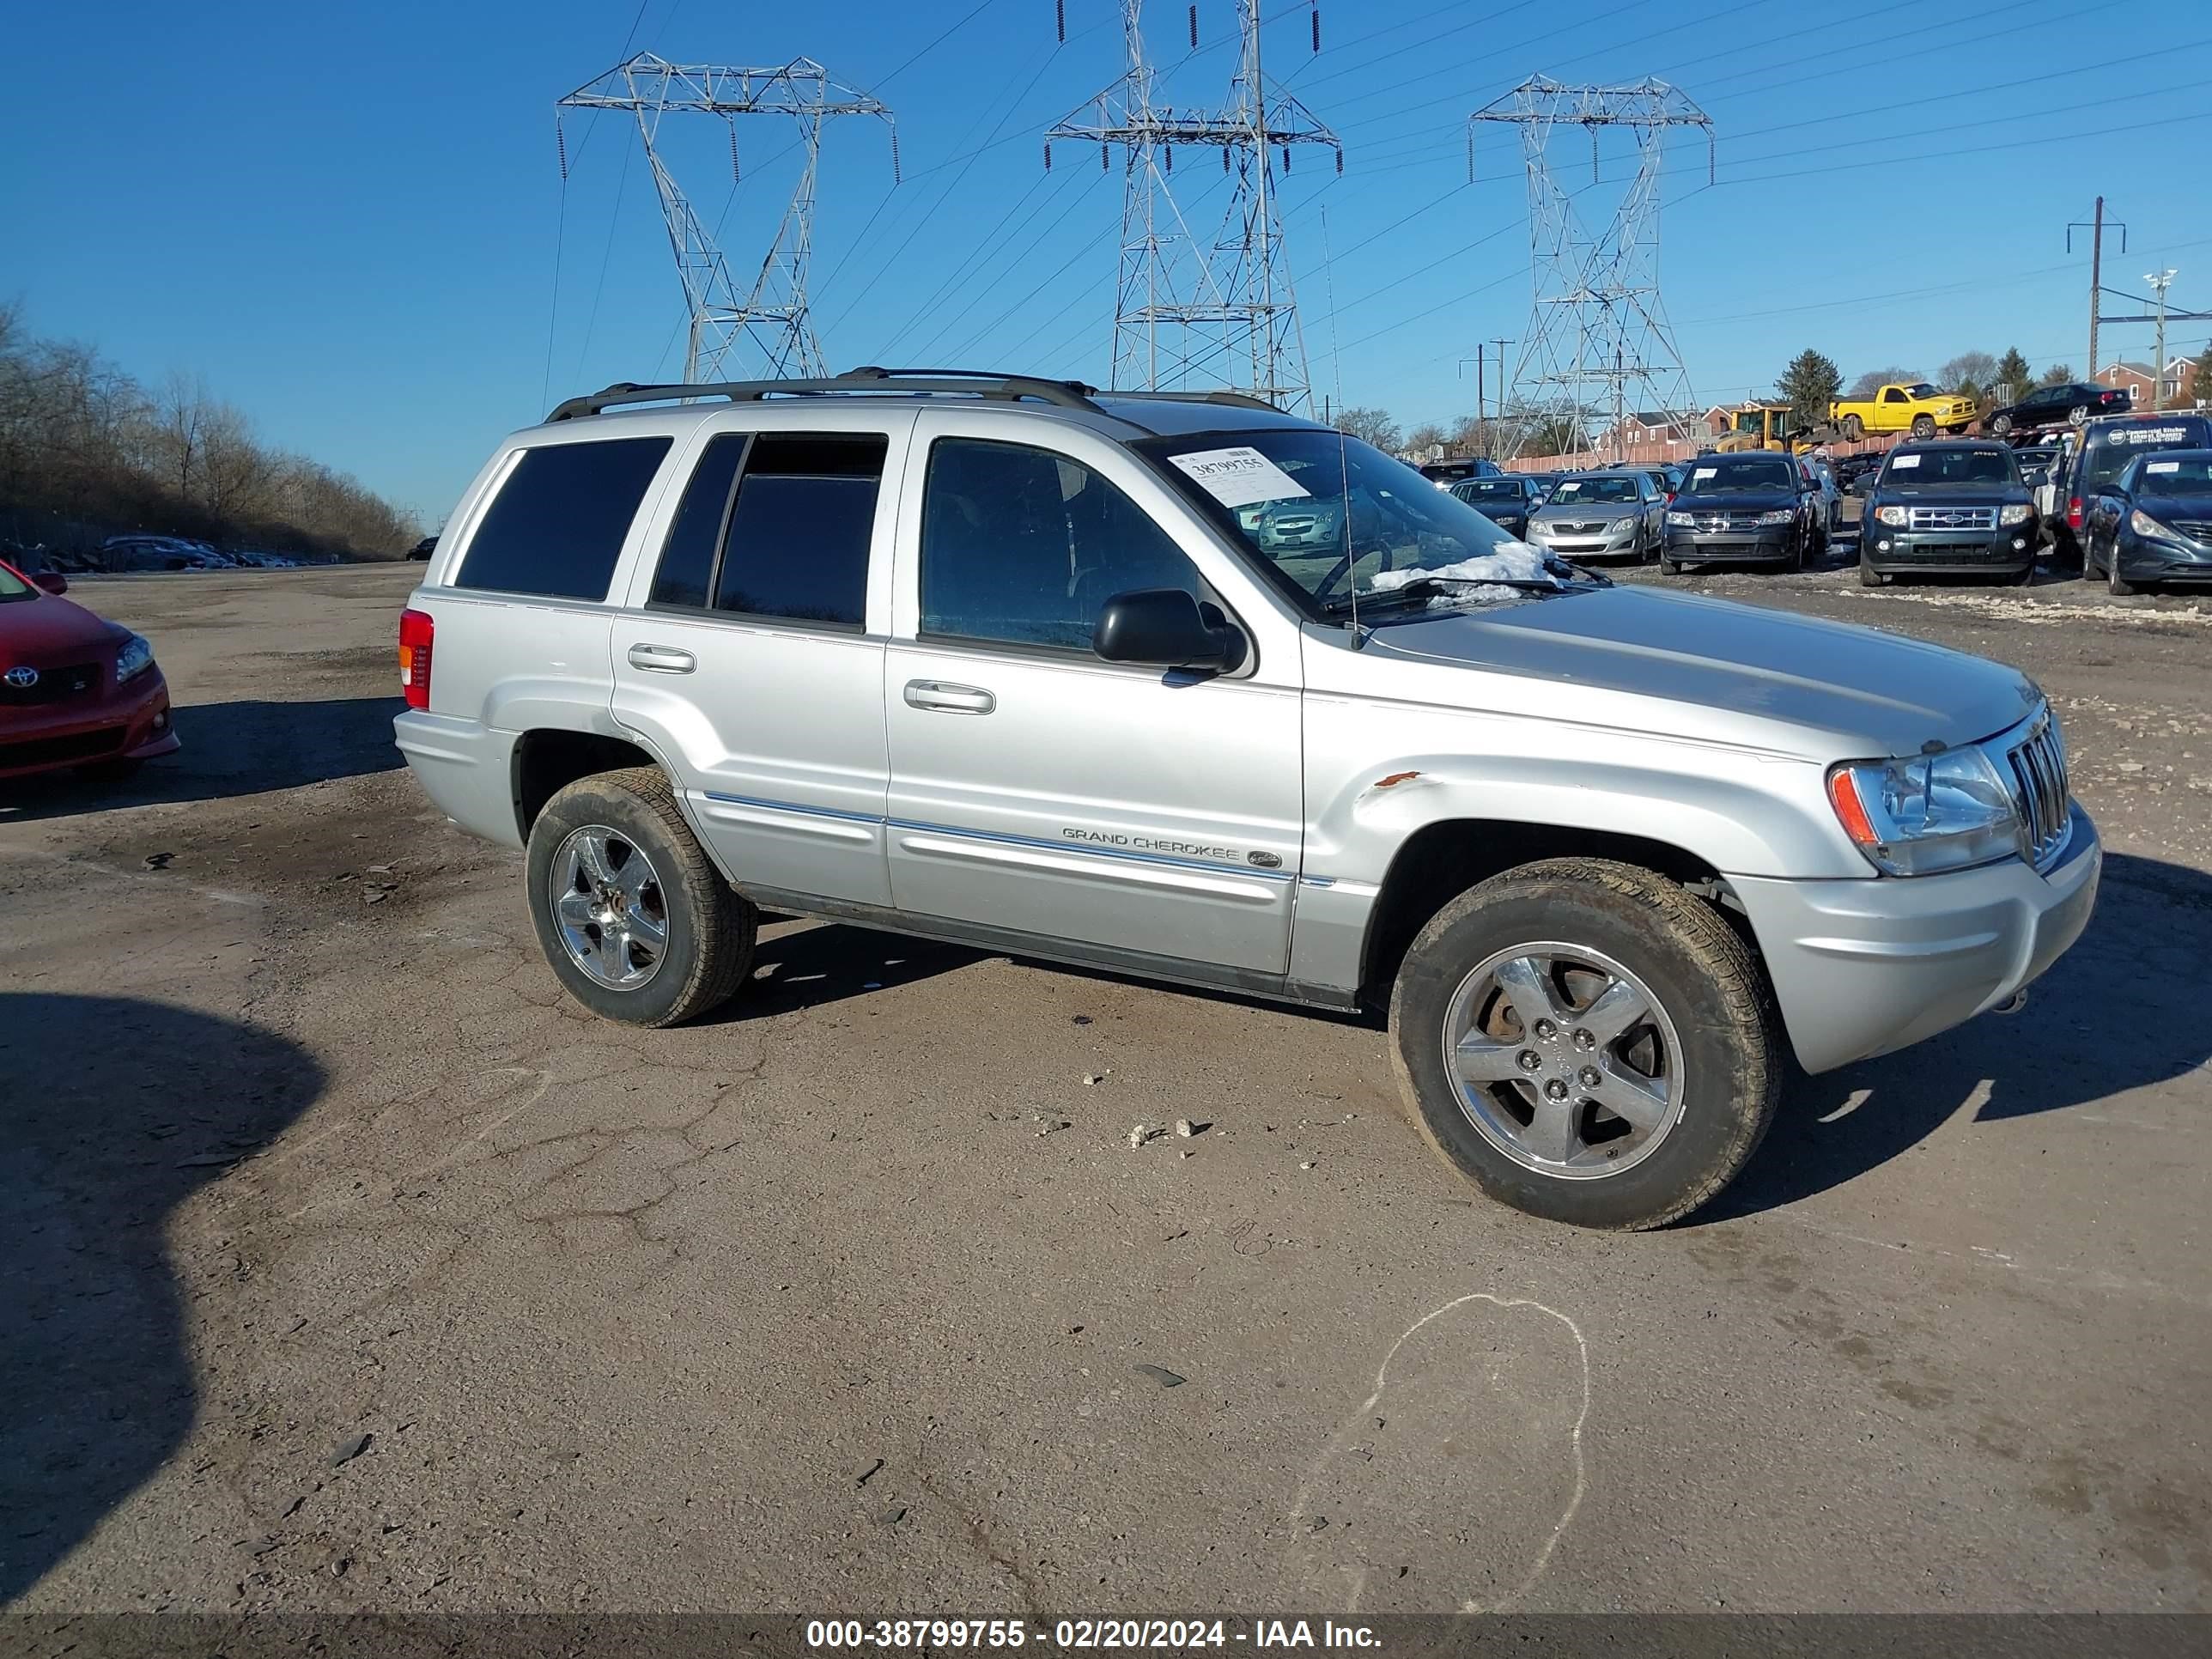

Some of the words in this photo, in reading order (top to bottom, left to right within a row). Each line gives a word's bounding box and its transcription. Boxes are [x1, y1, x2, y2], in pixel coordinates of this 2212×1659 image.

[1191, 458, 1264, 476] 38799755
[1062, 828, 1127, 845] GRAND
[1133, 836, 1240, 860] CHEROKEE
